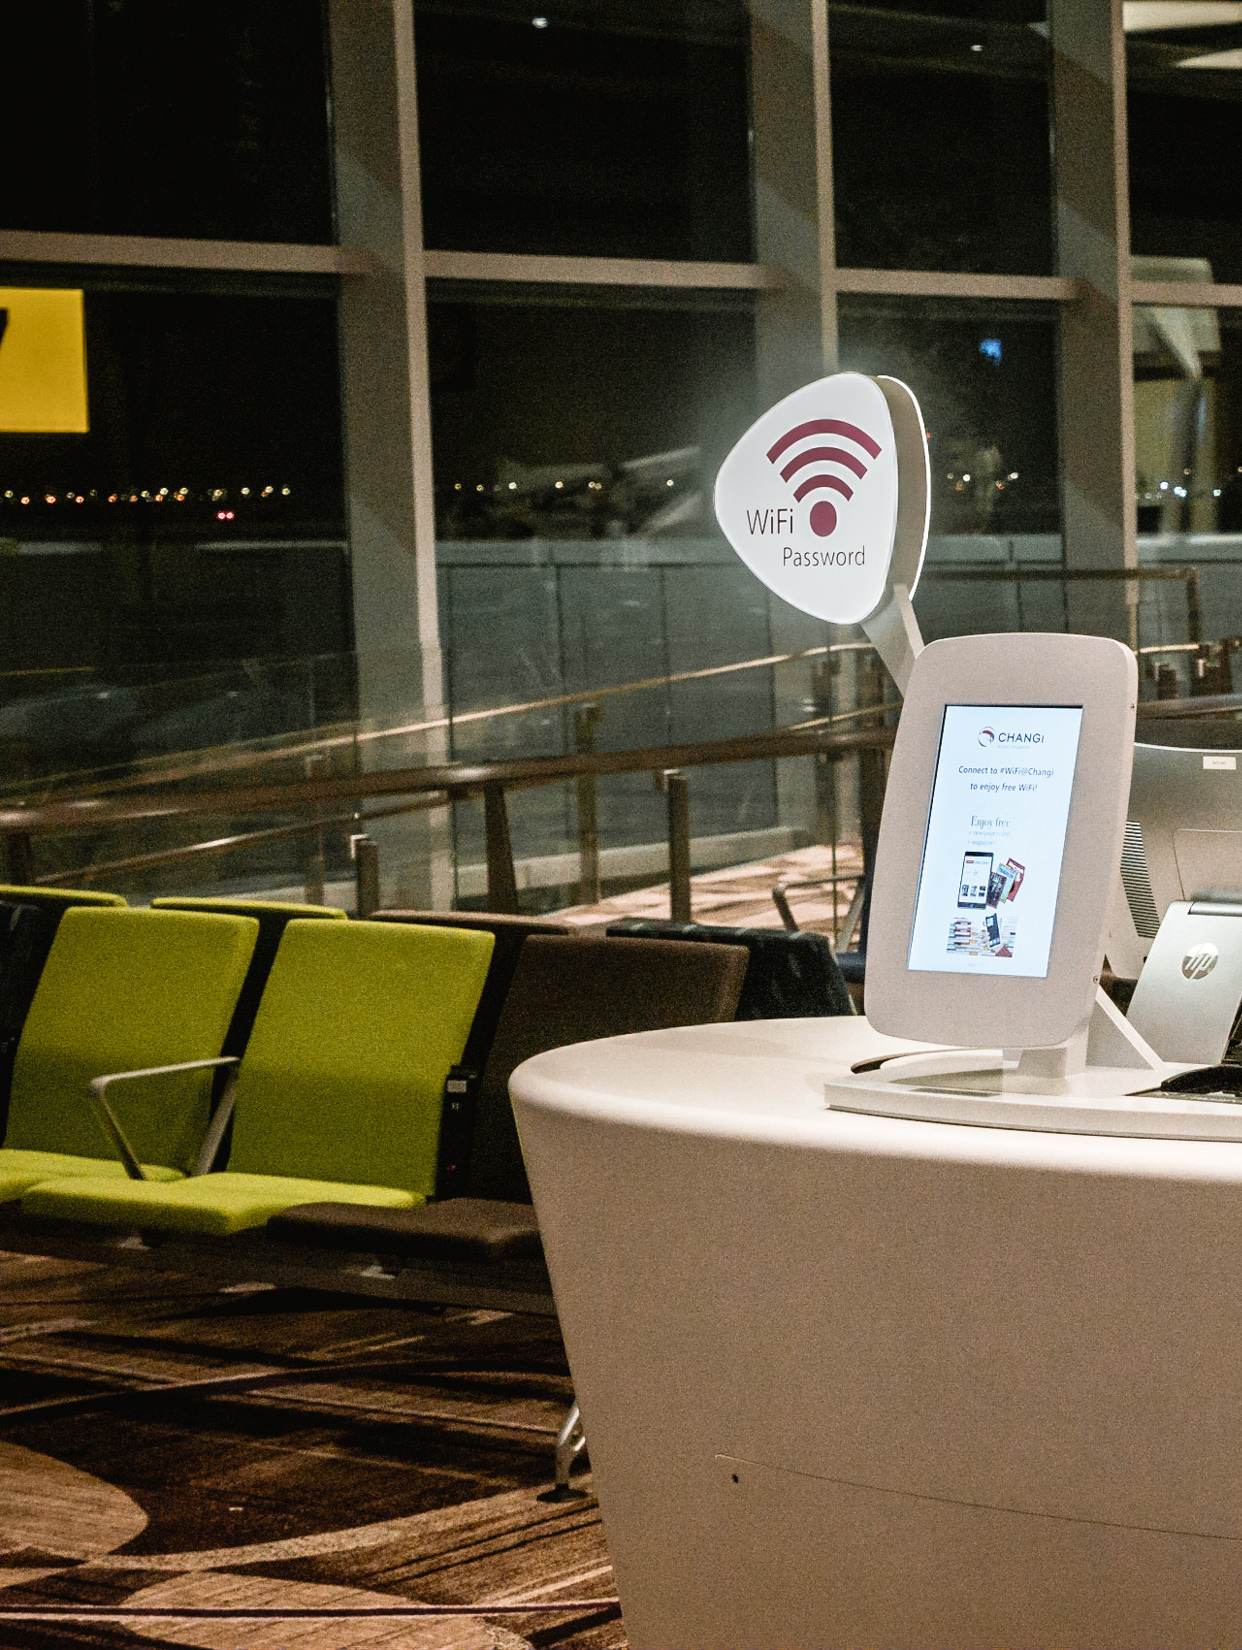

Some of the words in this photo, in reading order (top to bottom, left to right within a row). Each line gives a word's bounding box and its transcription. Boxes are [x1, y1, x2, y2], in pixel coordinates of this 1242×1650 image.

[746, 508, 794, 535] WiFi
[783, 545, 865, 567] Password
[998, 732, 1045, 744] CHANGI
[958, 765, 988, 775] Connect
[990, 767, 998, 775] to
[980, 783, 1000, 793] enjoy
[1001, 782, 1017, 791] free
[970, 815, 992, 830] Enjoy
